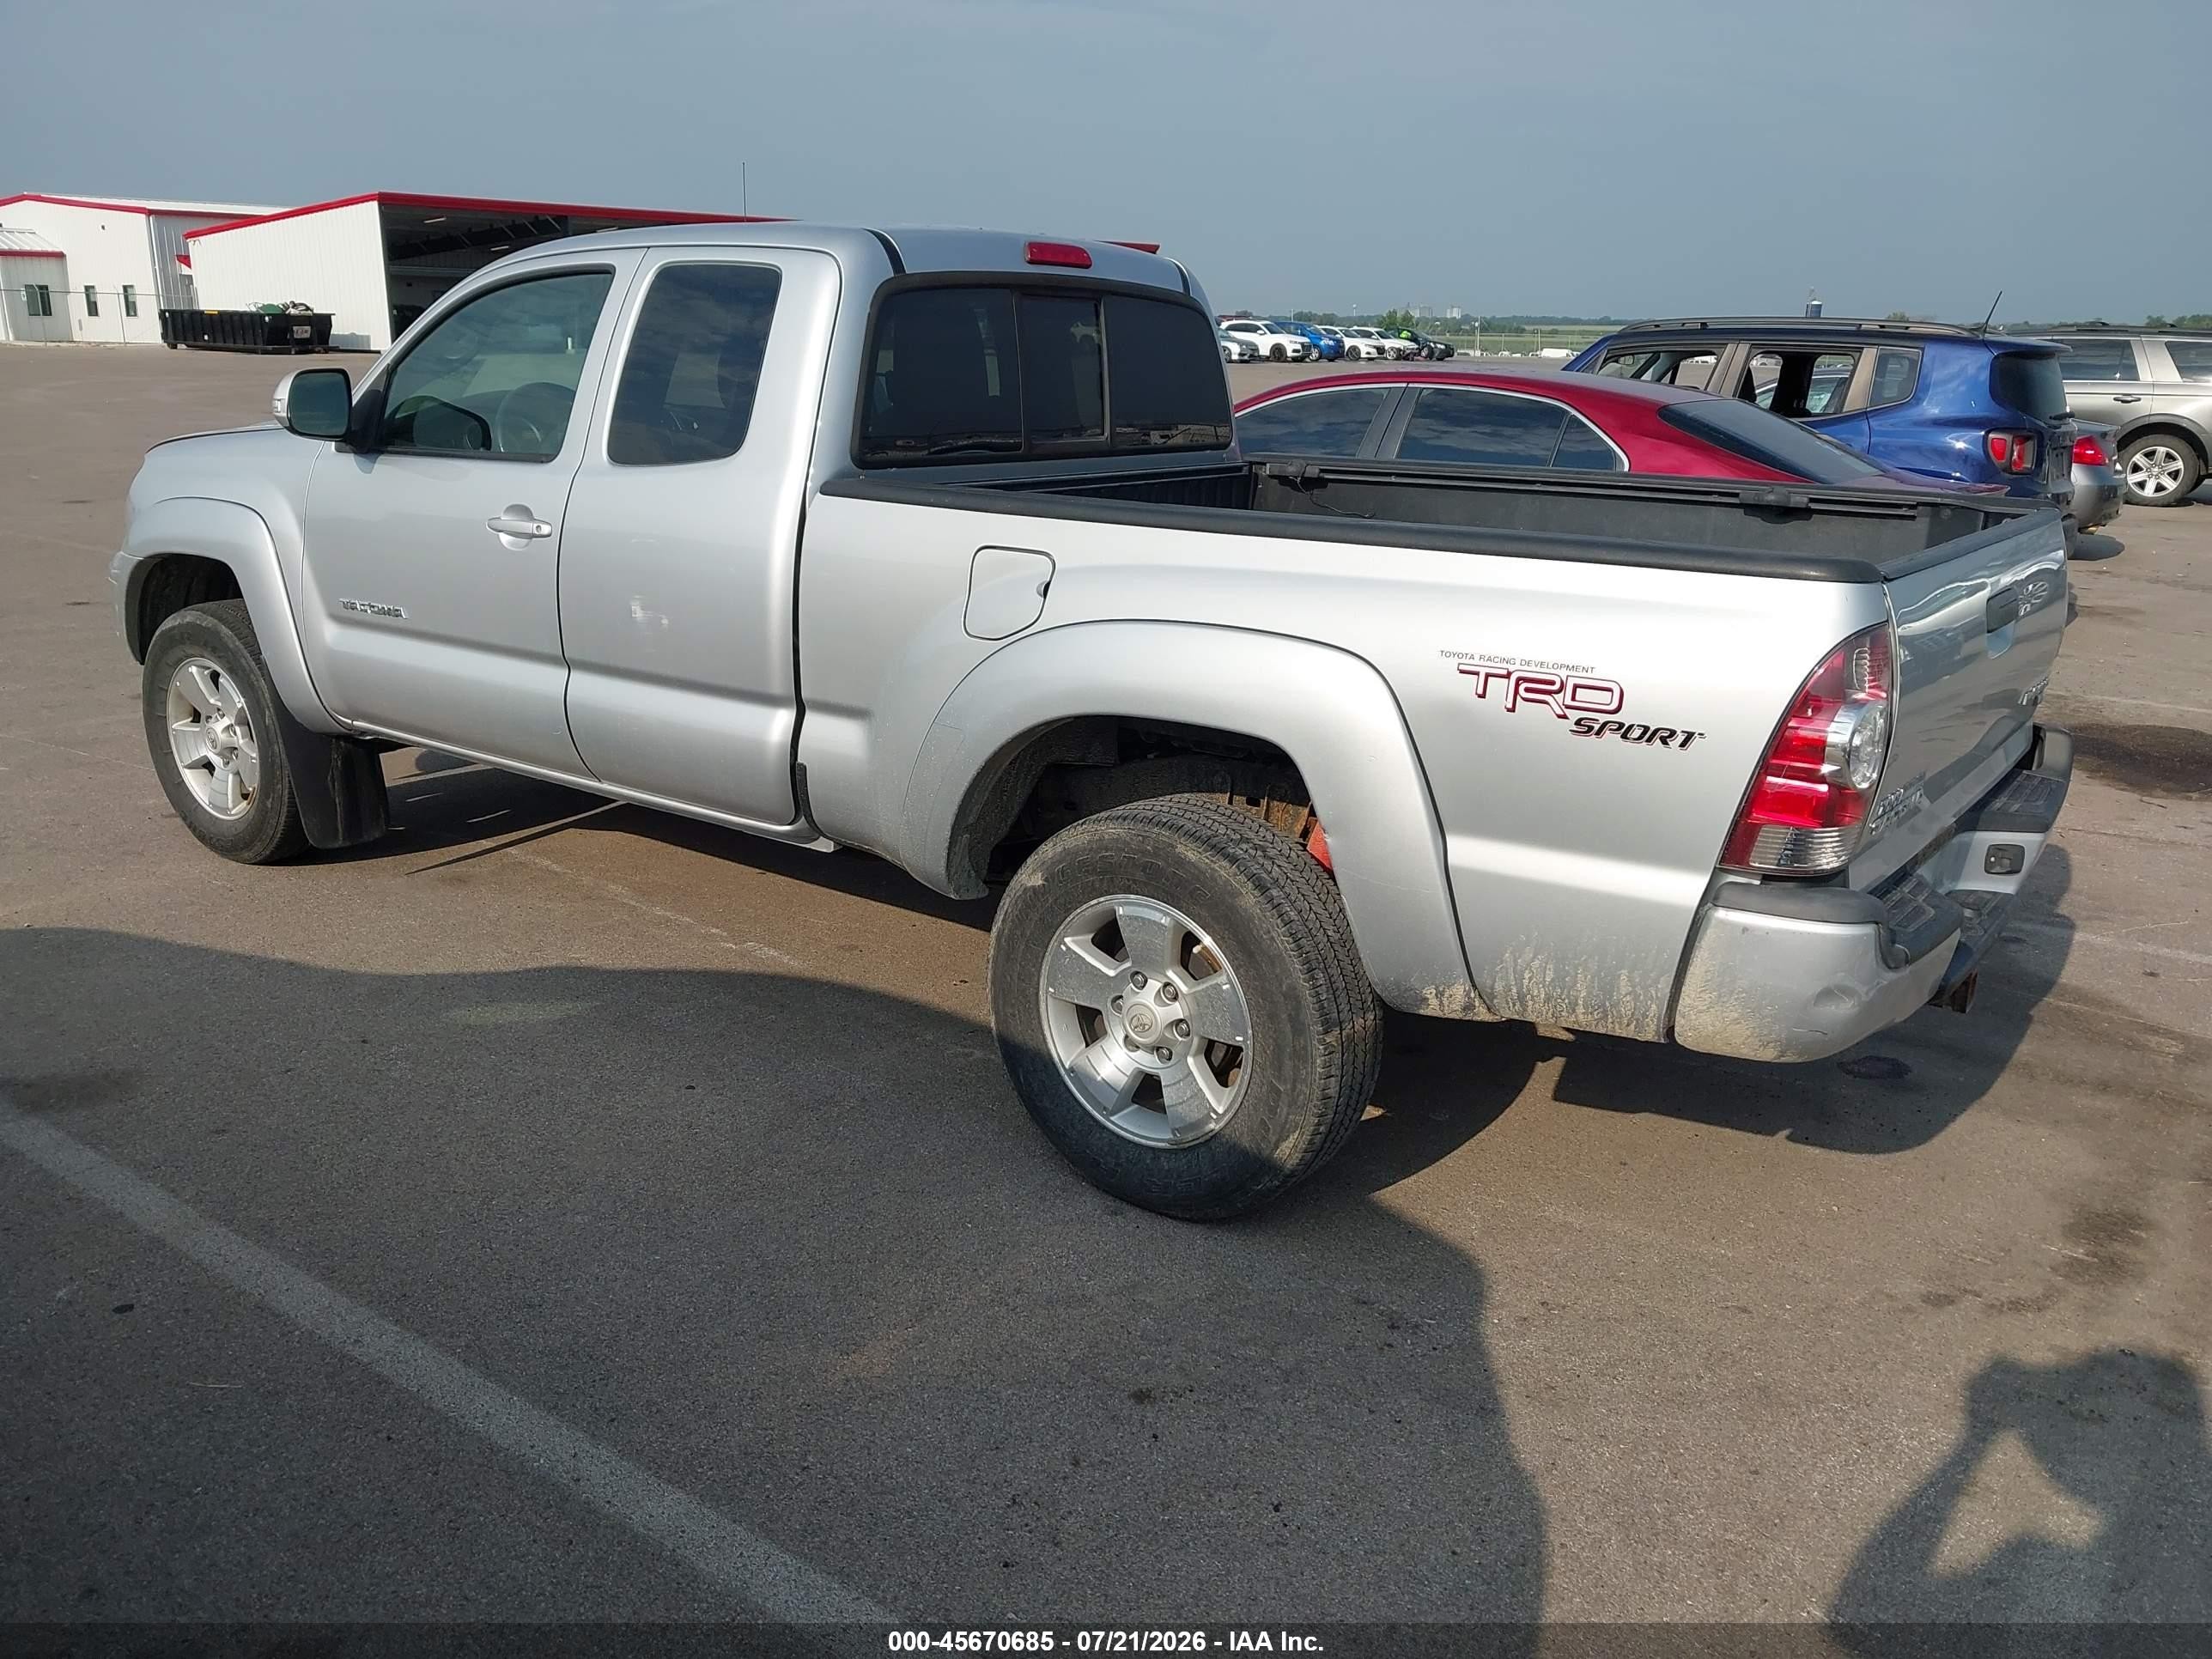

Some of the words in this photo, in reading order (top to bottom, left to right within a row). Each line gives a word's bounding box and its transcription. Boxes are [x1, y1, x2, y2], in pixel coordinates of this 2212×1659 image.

[1439, 649, 1475, 661] TOYOTA
[1479, 654, 1516, 665] RACING
[1520, 659, 1596, 674] DEVELOPMENT
[1456, 662, 1625, 720] TRD
[1569, 716, 1699, 751] SPORT
